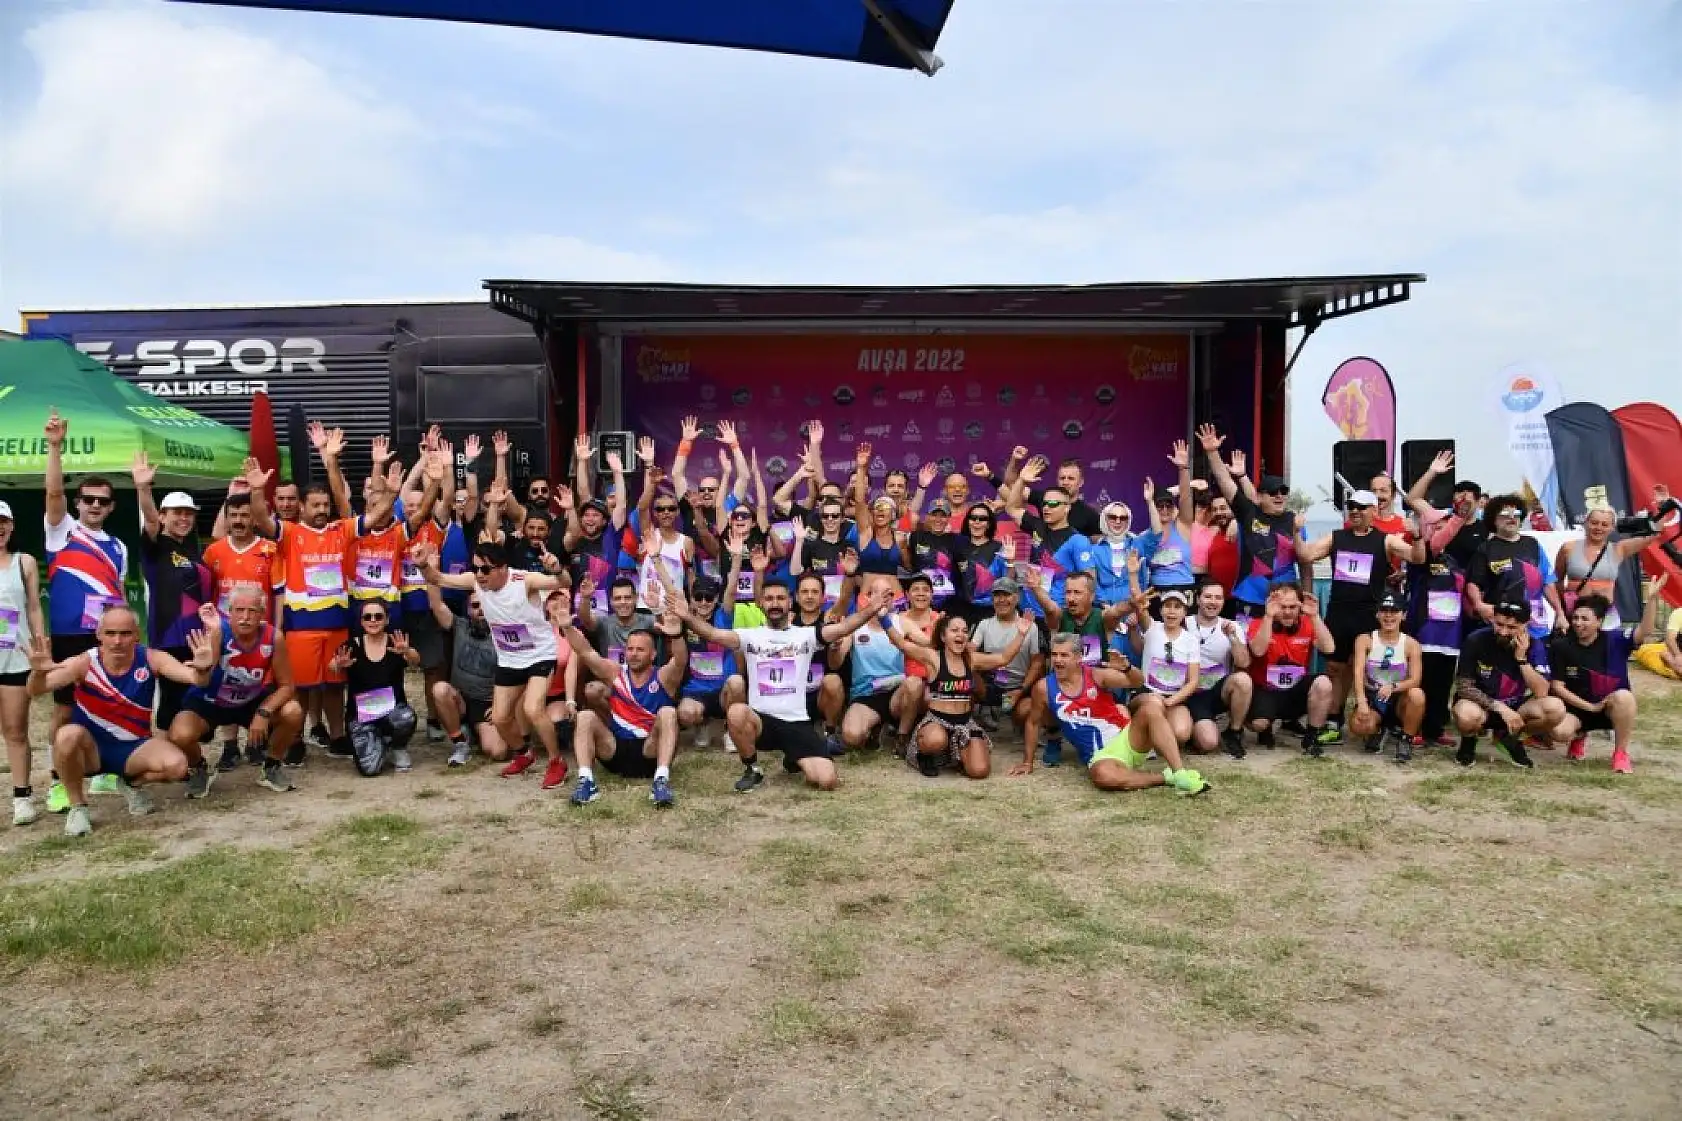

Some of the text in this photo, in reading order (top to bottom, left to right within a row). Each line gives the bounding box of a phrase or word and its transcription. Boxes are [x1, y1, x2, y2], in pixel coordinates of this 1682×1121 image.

[76, 337, 326, 375] E-SPOR
[858, 348, 965, 377] AVŞA 2022
[502, 630, 521, 643] 113
[769, 667, 784, 683] 47
[1278, 673, 1292, 685] 85
